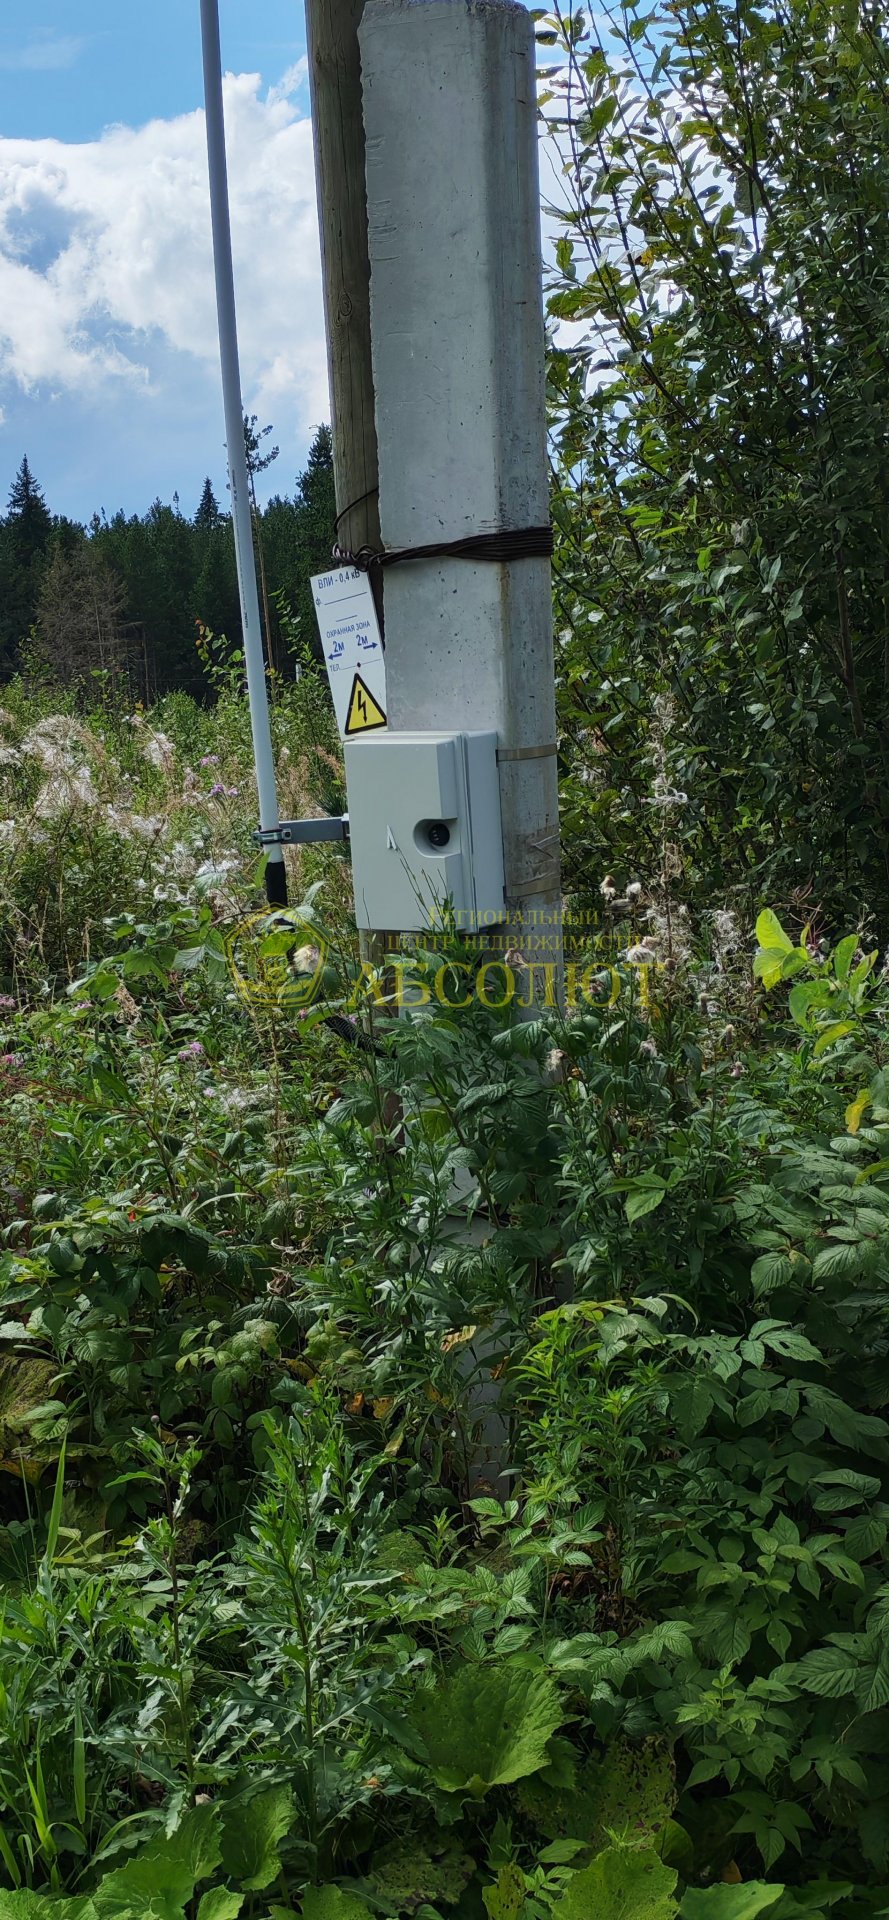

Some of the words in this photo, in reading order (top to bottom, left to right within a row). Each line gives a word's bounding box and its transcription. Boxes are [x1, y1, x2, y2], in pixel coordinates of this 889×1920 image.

[318, 576, 333, 589] ВЛИ
[339, 570, 350, 584] 0,4
[326, 624, 355, 639] ОХРАННАЯ
[356, 620, 371, 631] ЗОНА
